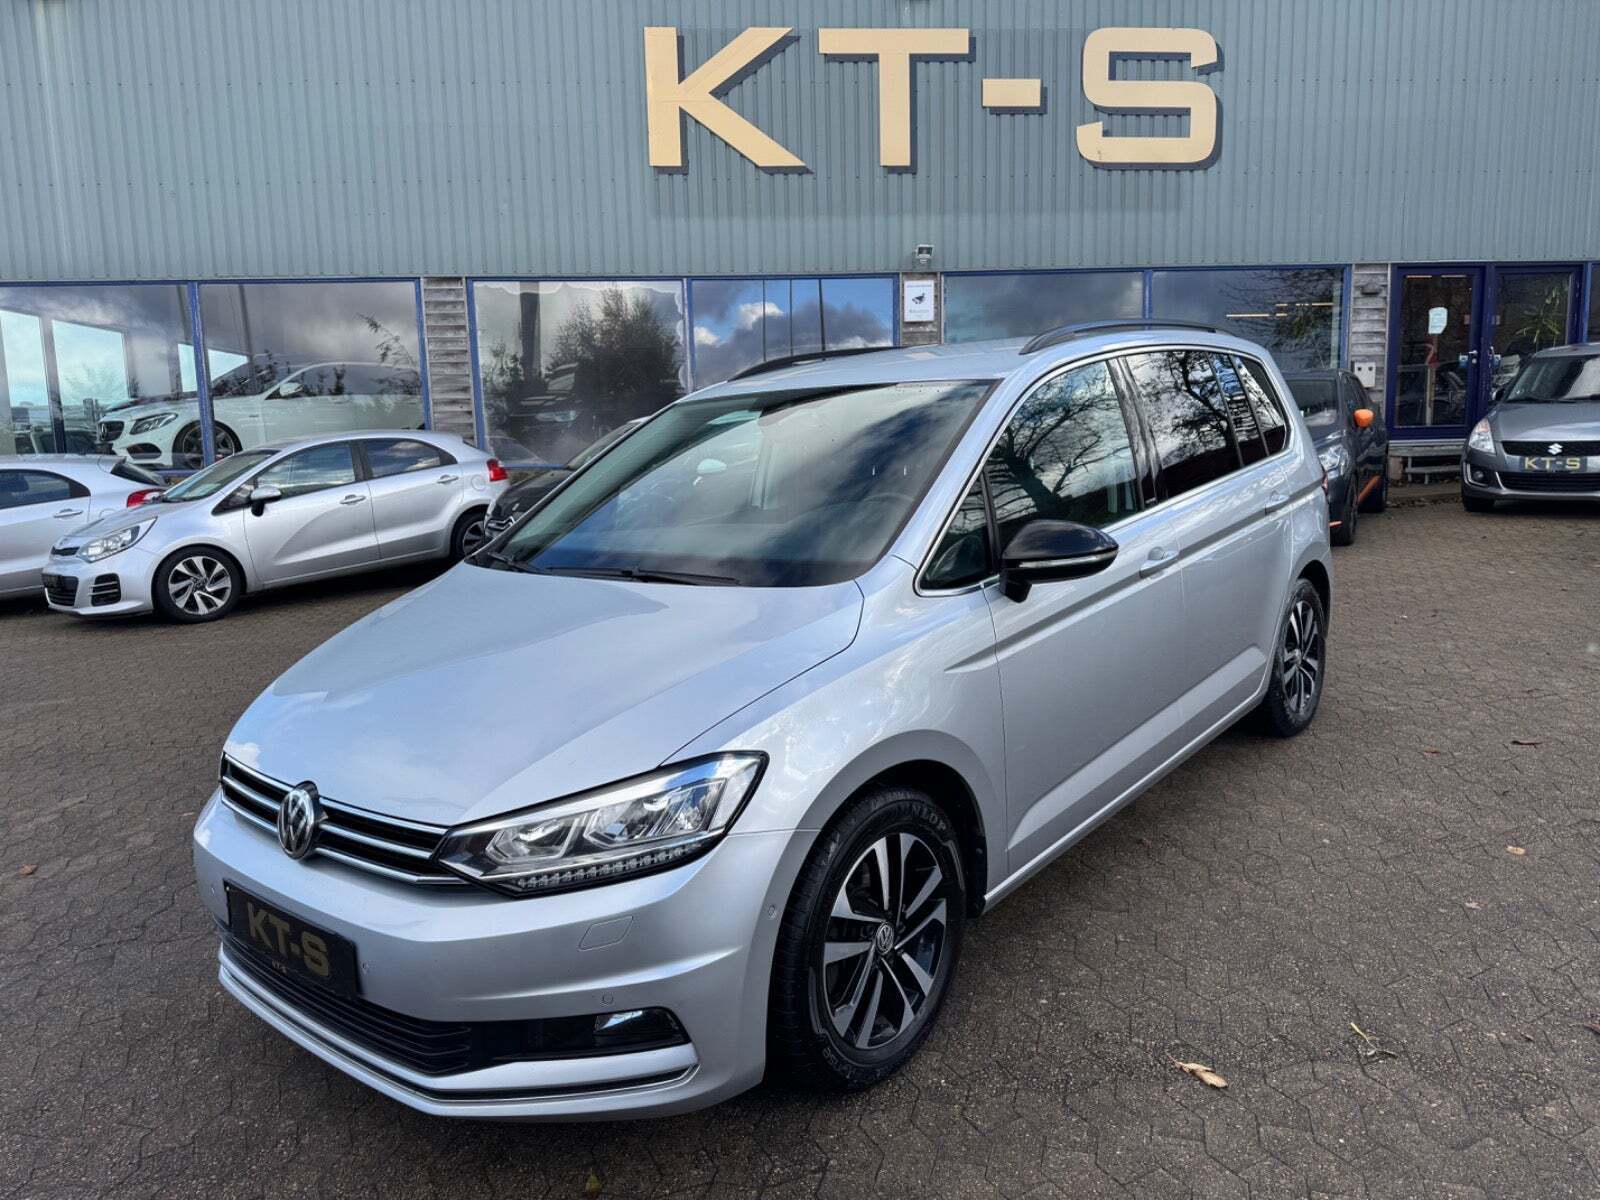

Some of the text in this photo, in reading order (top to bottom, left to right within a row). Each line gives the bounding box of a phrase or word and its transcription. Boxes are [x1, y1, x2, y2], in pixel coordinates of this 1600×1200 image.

[644, 27, 1218, 167] KT-S
[1524, 456, 1580, 470] KT-S
[247, 902, 330, 977] KT-S
